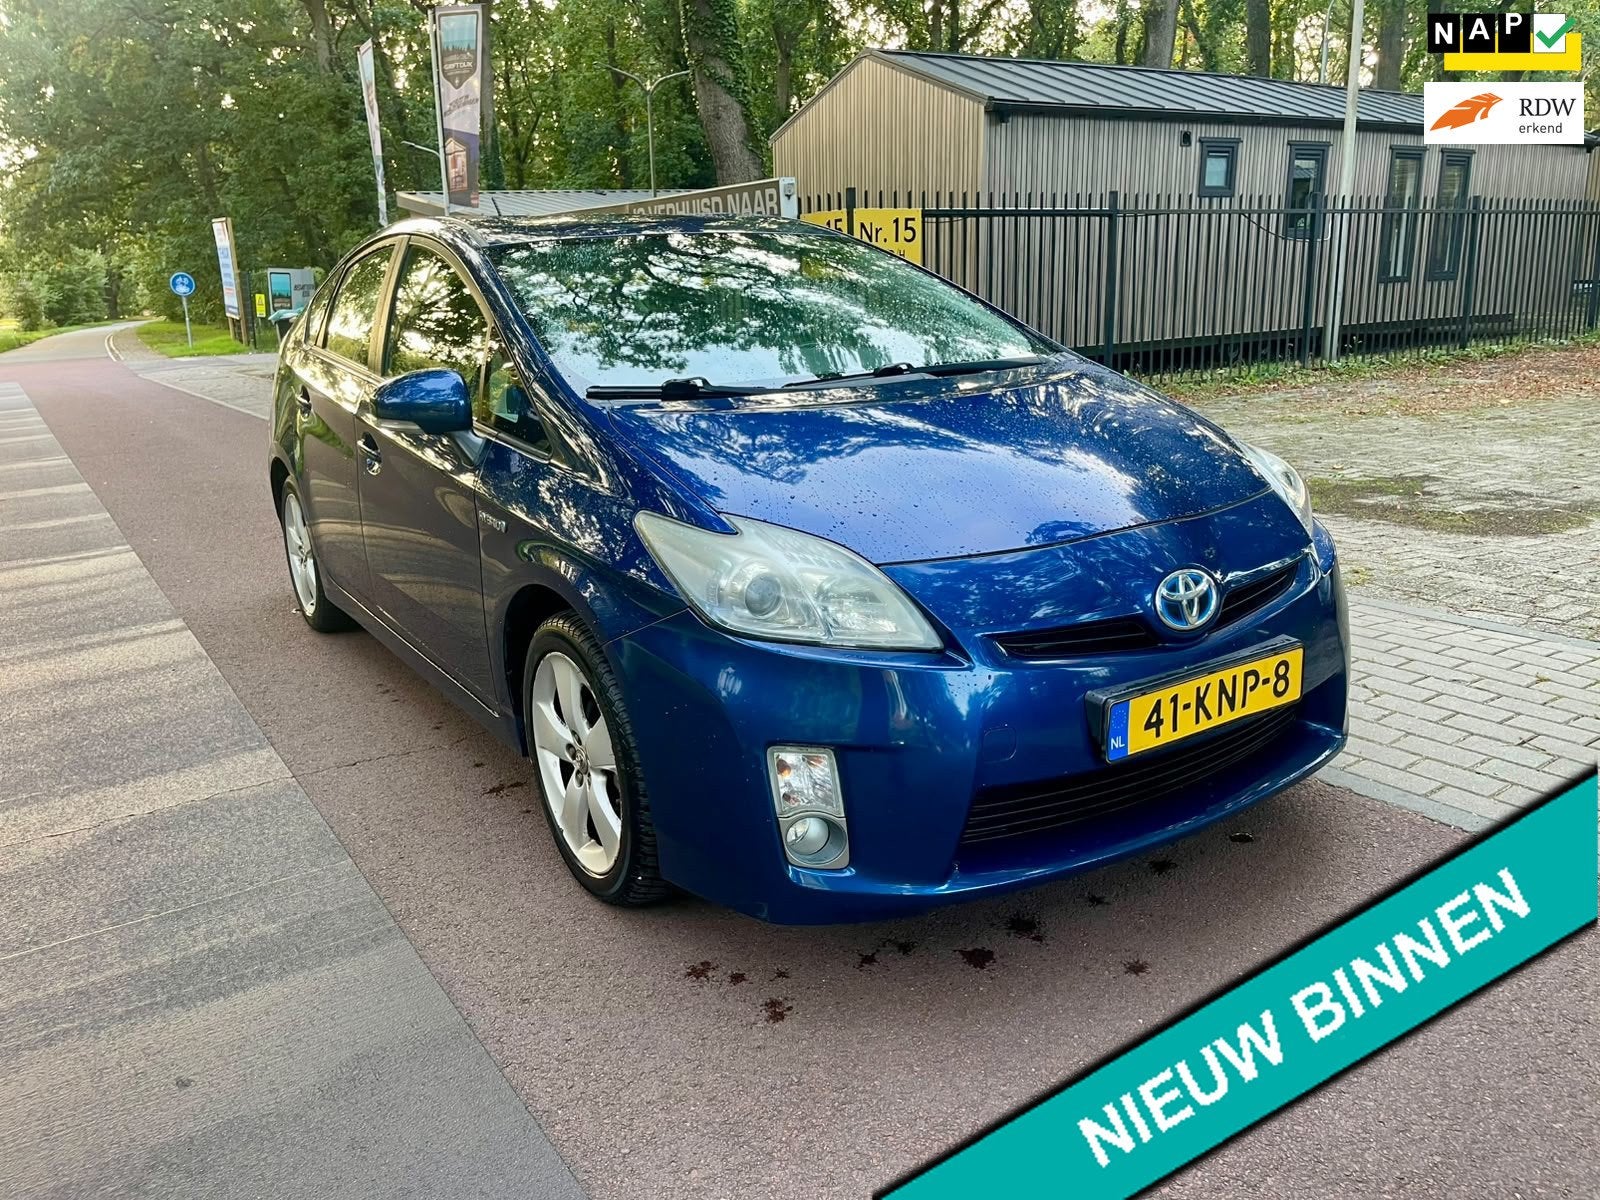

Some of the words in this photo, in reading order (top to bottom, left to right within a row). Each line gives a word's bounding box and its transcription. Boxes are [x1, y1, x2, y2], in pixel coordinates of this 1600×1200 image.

[648, 196, 723, 217] HUISD
[726, 187, 779, 218] NAAR
[859, 221, 888, 243] Nr.
[892, 216, 917, 243] 15
[1143, 659, 1291, 739] 41-KNP-8
[1110, 735, 1126, 750] NL
